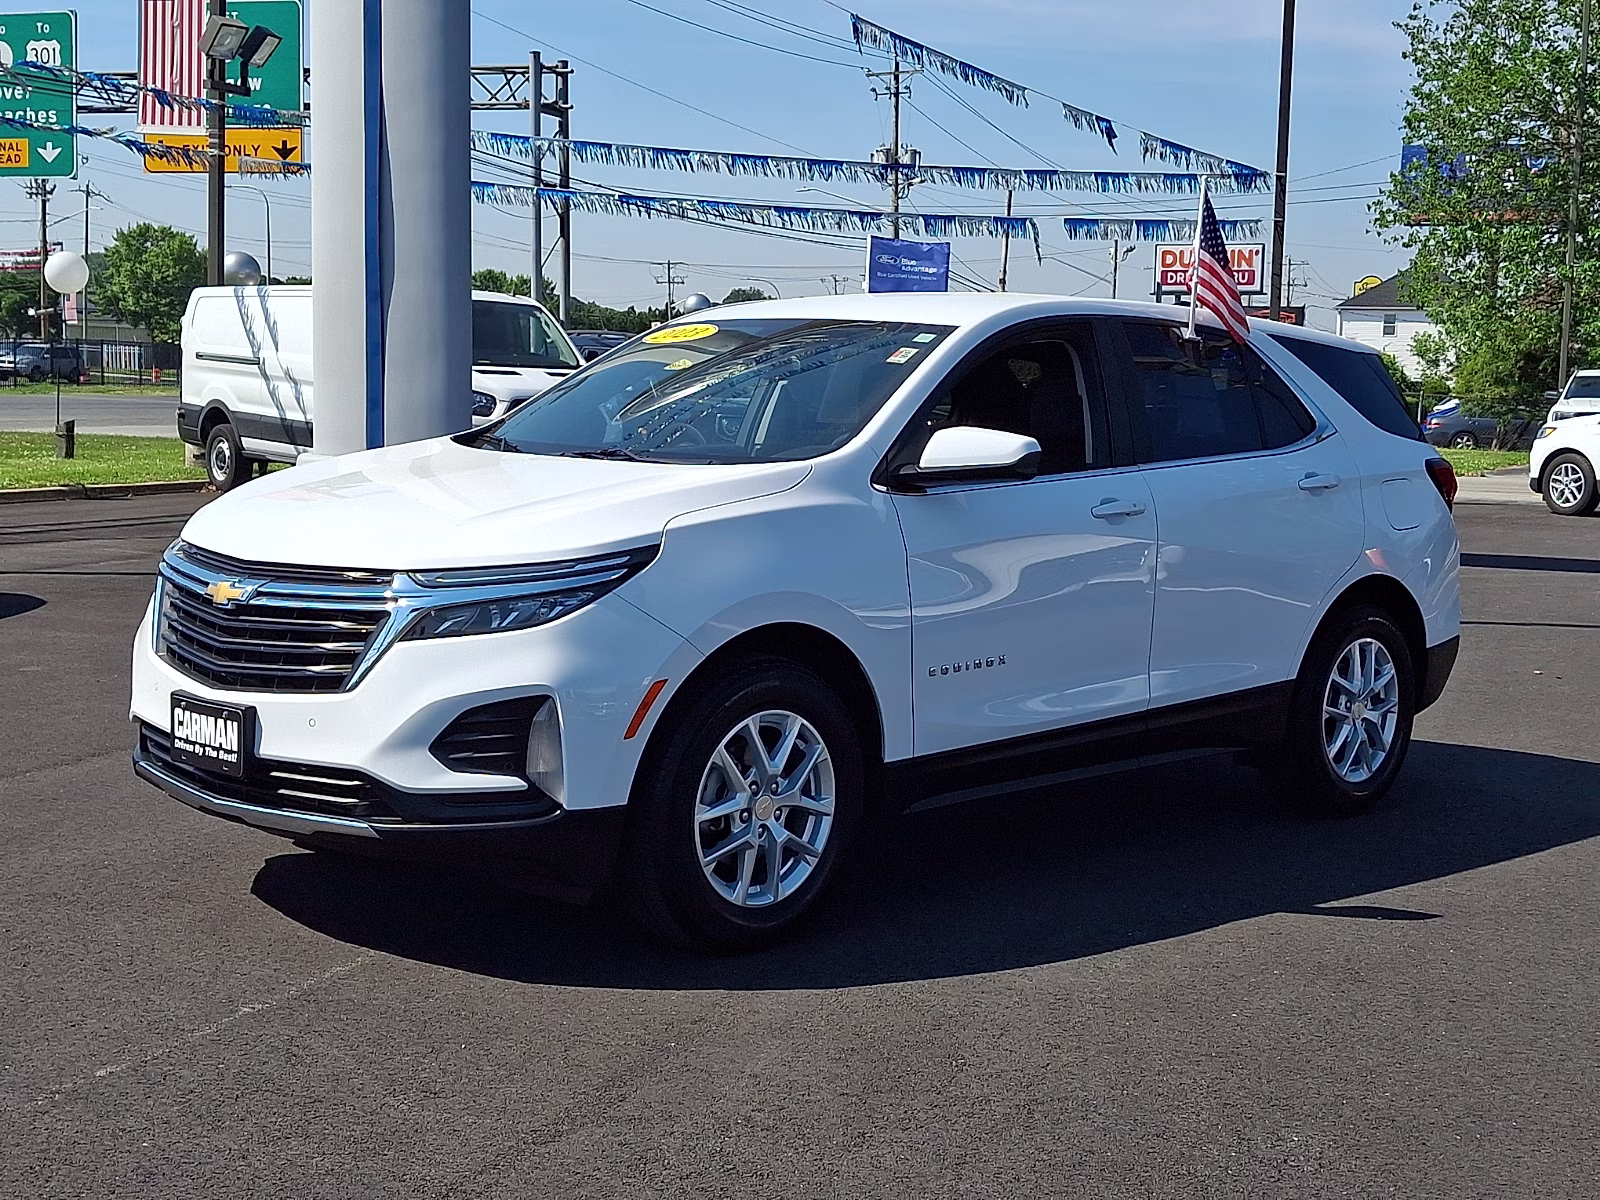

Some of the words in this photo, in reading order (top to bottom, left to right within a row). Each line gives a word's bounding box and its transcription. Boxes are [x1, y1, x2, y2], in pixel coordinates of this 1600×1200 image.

[36, 22, 50, 33] To
[30, 47, 56, 64] 301
[0, 86, 33, 99] ver
[0, 106, 57, 123] aches
[0, 142, 22, 152] NAL
[0, 154, 21, 164] EAD
[901, 258, 917, 266] Blue
[1161, 249, 1260, 268] DUIN'
[901, 265, 938, 274] Advantage
[928, 654, 1007, 677] EQUINOX
[173, 707, 239, 752] CARMAN
[174, 738, 195, 753] Driven
[195, 743, 204, 757] By
[205, 746, 218, 758] The
